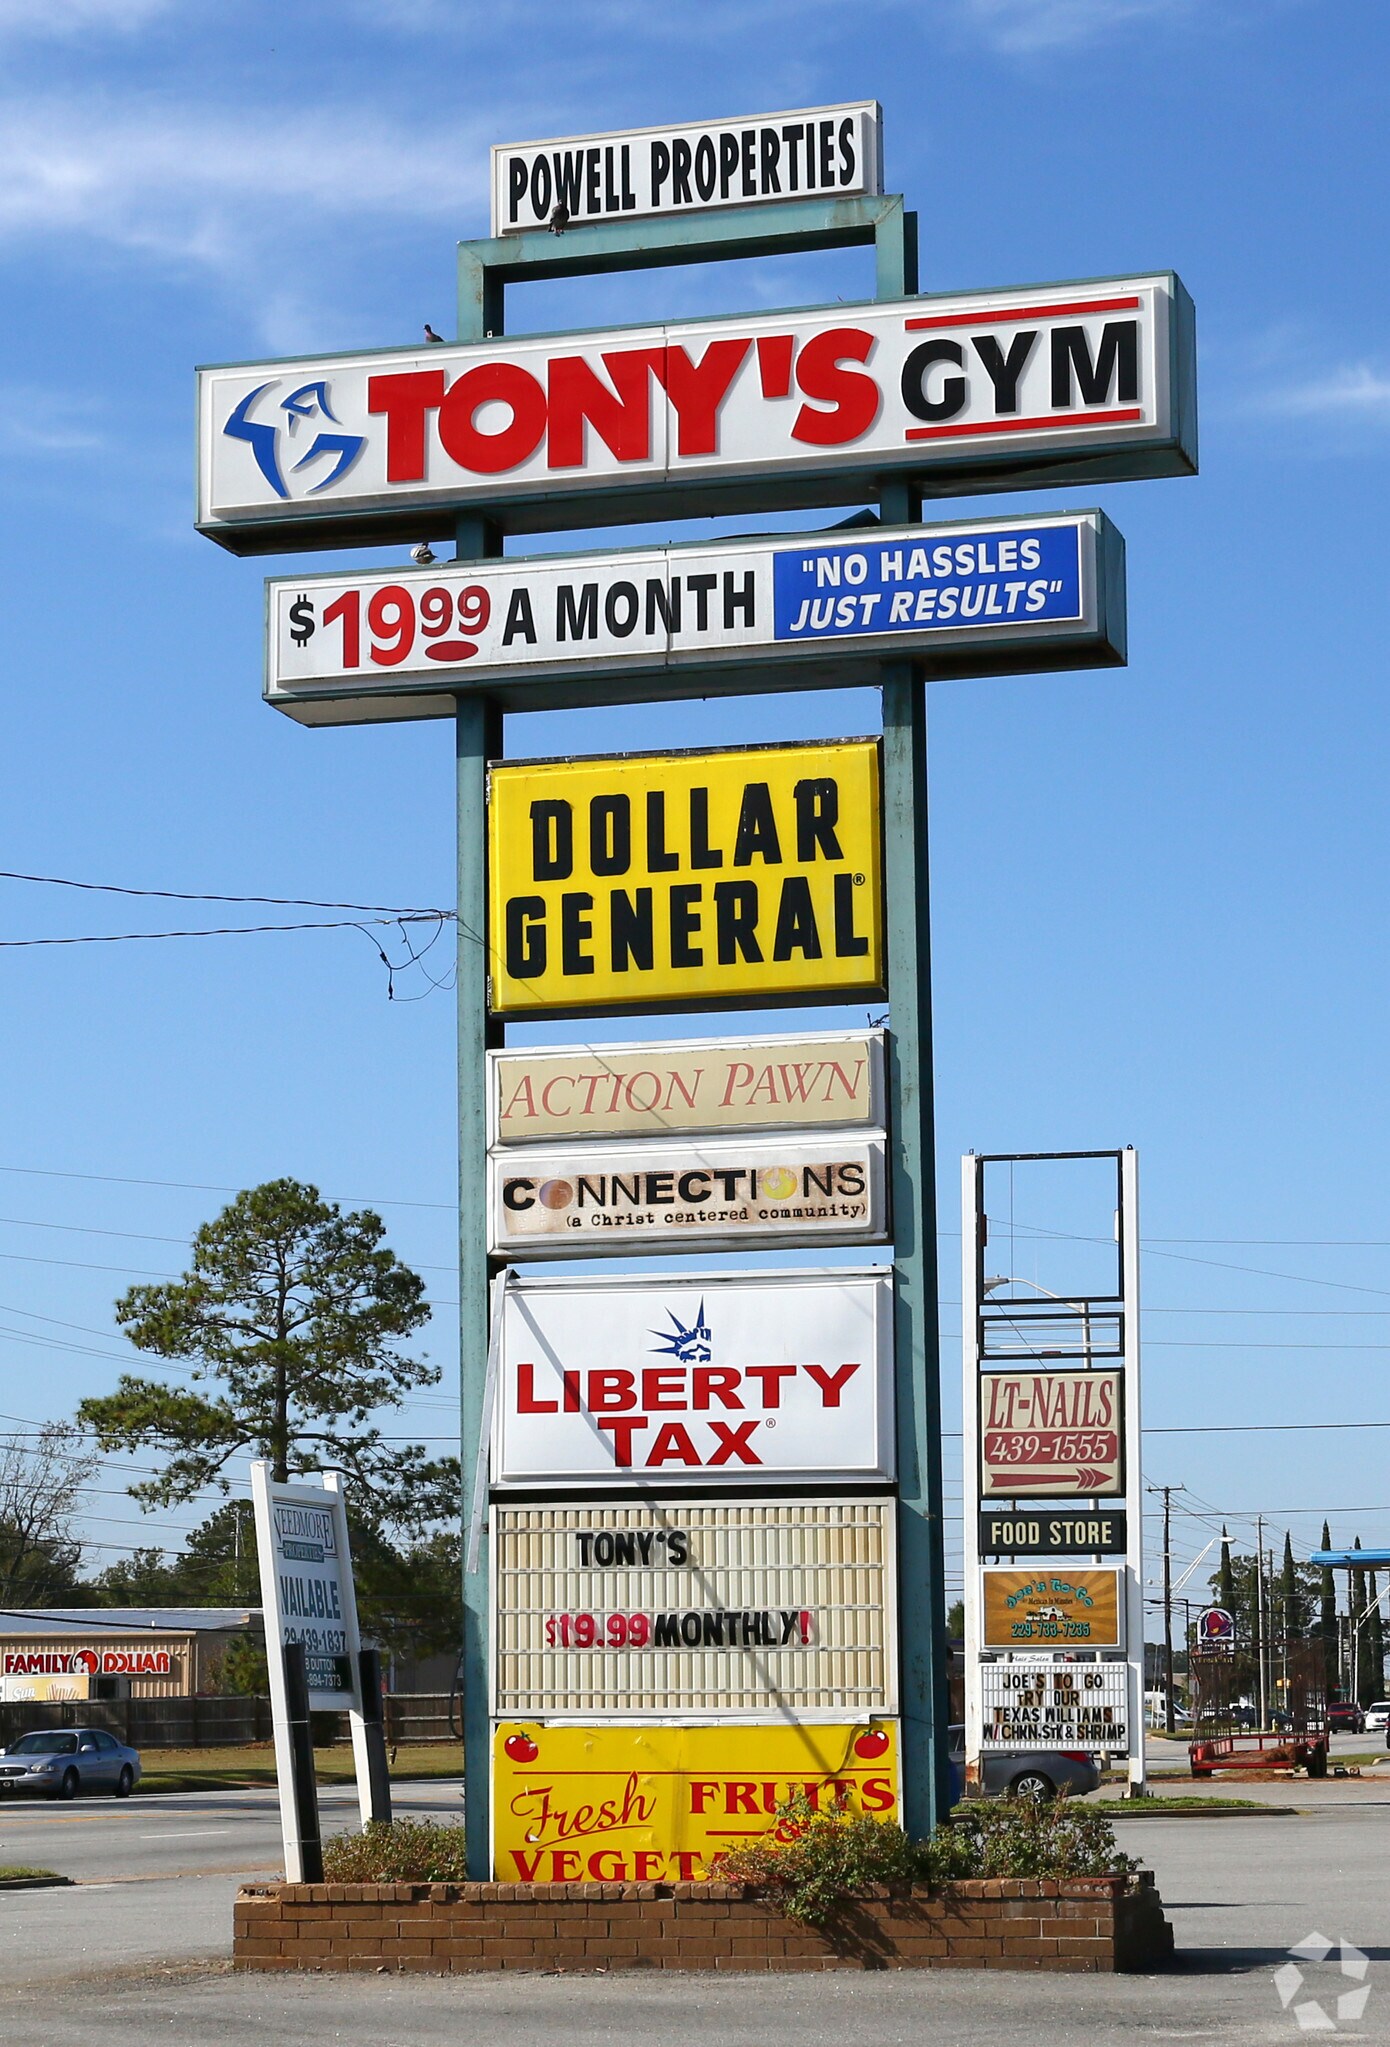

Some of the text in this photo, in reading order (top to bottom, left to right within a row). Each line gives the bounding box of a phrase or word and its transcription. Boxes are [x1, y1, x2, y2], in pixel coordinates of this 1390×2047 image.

[509, 117, 856, 223] POWELL PROPERTIES
[367, 319, 1140, 484] TONY'S GYM
[802, 538, 1041, 588] "NO HASSLES
[502, 588, 537, 646] A
[556, 570, 755, 642] MONTH
[789, 580, 1063, 632] JUST RESULTS"
[529, 776, 844, 882] DOLLAR
[501, 1059, 866, 1119] ACTION PAWN
[591, 1212, 655, 1227] Christ
[664, 1206, 749, 1223] centered
[758, 1202, 868, 1222] community)
[516, 1363, 862, 1414] LIBERTY
[986, 1377, 1114, 1429] LT-NAILS
[990, 1433, 1111, 1462] 439-1555
[576, 1530, 688, 1567] TONY'S
[991, 1520, 1112, 1545] FOOD STORE
[280, 1575, 341, 1620] VAILABLE
[546, 1610, 811, 1649] $19.99 MONTHLY!
[4, 1651, 170, 1674] FAMILY DOLLAR
[1003, 1673, 1045, 1690] JOE'S
[1084, 1673, 1103, 1690] GO
[994, 1707, 1113, 1723] TEXAS WILLIAMS
[1017, 1690, 1080, 1706] TRY OUR
[1077, 1724, 1126, 1740] SHRIMP
[510, 1771, 656, 1844] Fresh
[689, 1778, 896, 1815] FRUITS
